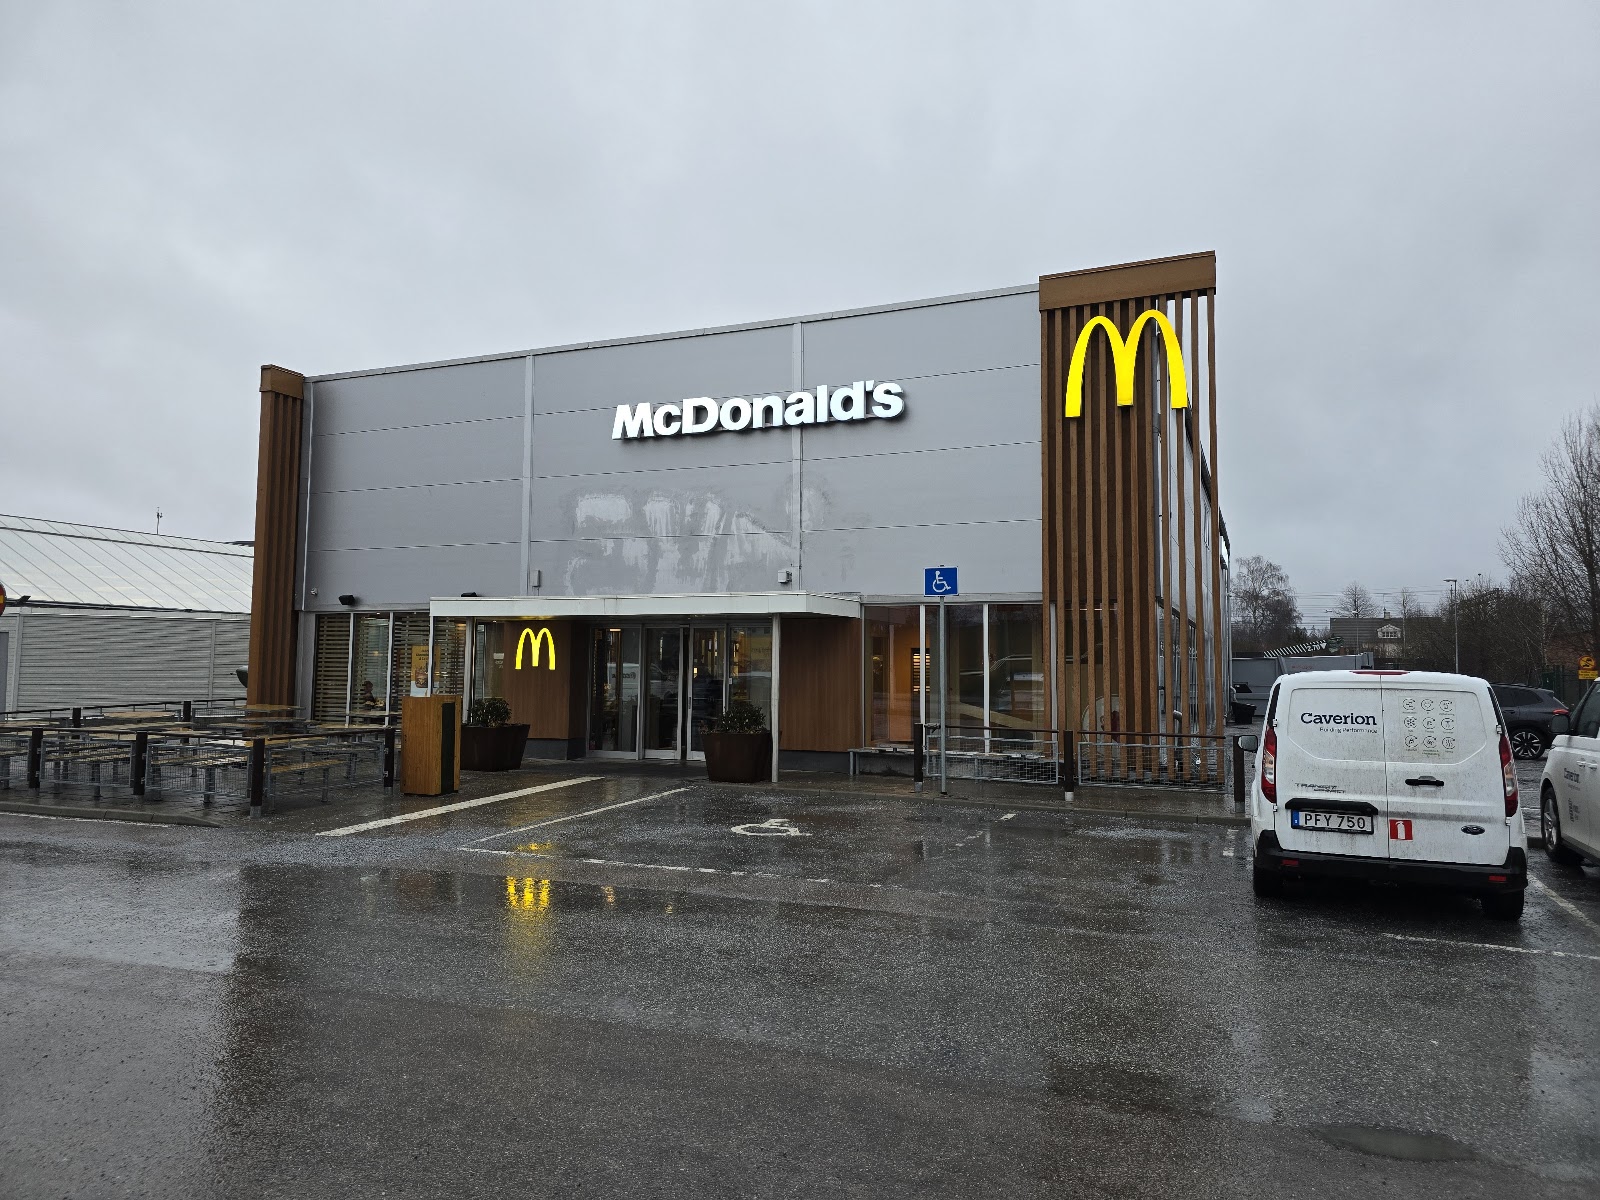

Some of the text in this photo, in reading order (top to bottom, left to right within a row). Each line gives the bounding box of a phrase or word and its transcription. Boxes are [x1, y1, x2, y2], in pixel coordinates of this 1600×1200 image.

[611, 379, 905, 440] McDonald's
[1300, 712, 1378, 725] Caverion
[1319, 726, 1341, 734] Buiding
[1304, 813, 1366, 830] PFY 750
